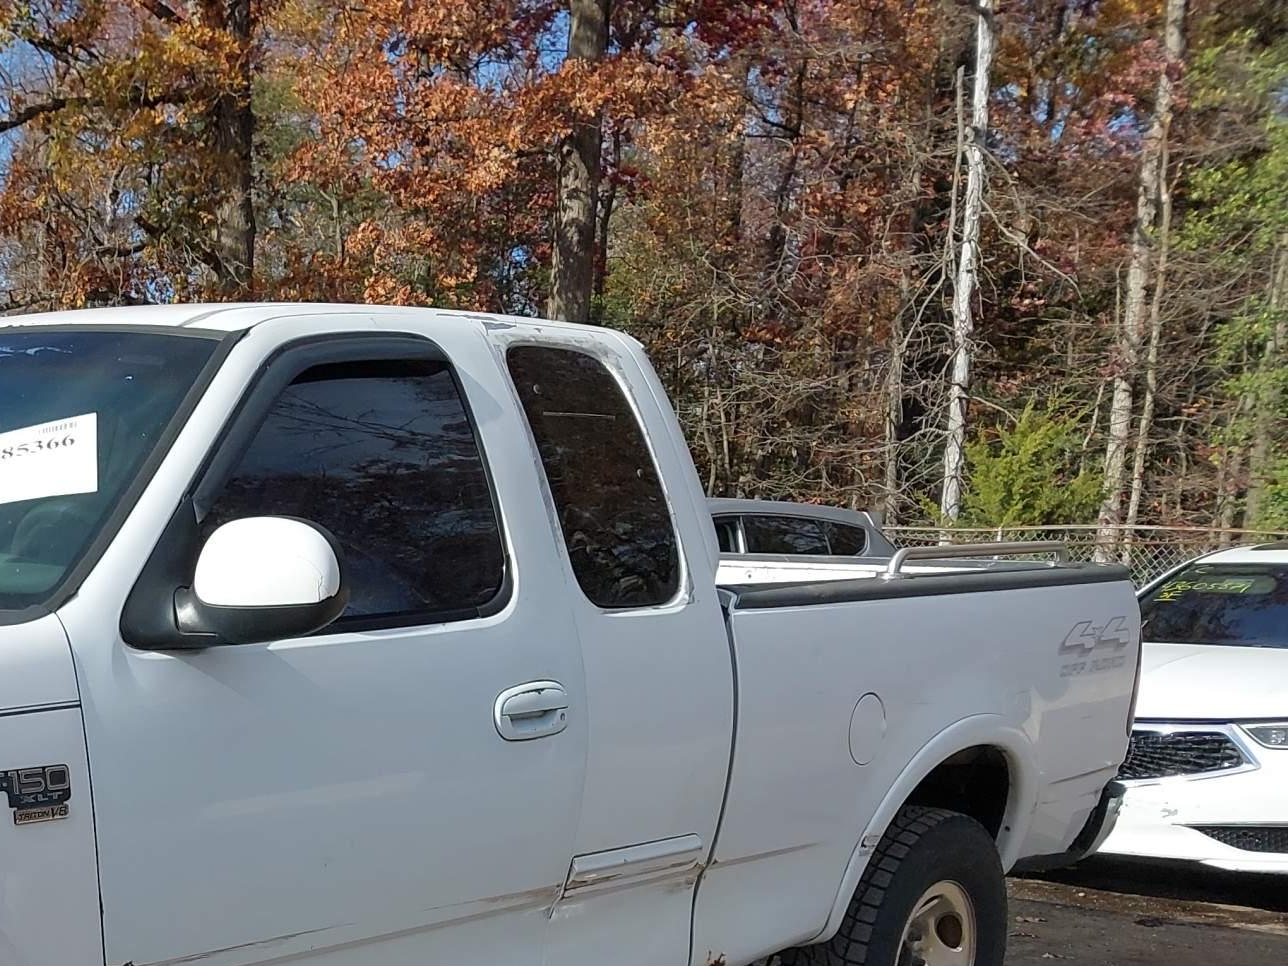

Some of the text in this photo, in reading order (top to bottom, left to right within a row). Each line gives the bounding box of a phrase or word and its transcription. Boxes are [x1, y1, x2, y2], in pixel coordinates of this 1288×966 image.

[20, 791, 64, 804] XLT
[18, 806, 68, 821] TRITON V8
